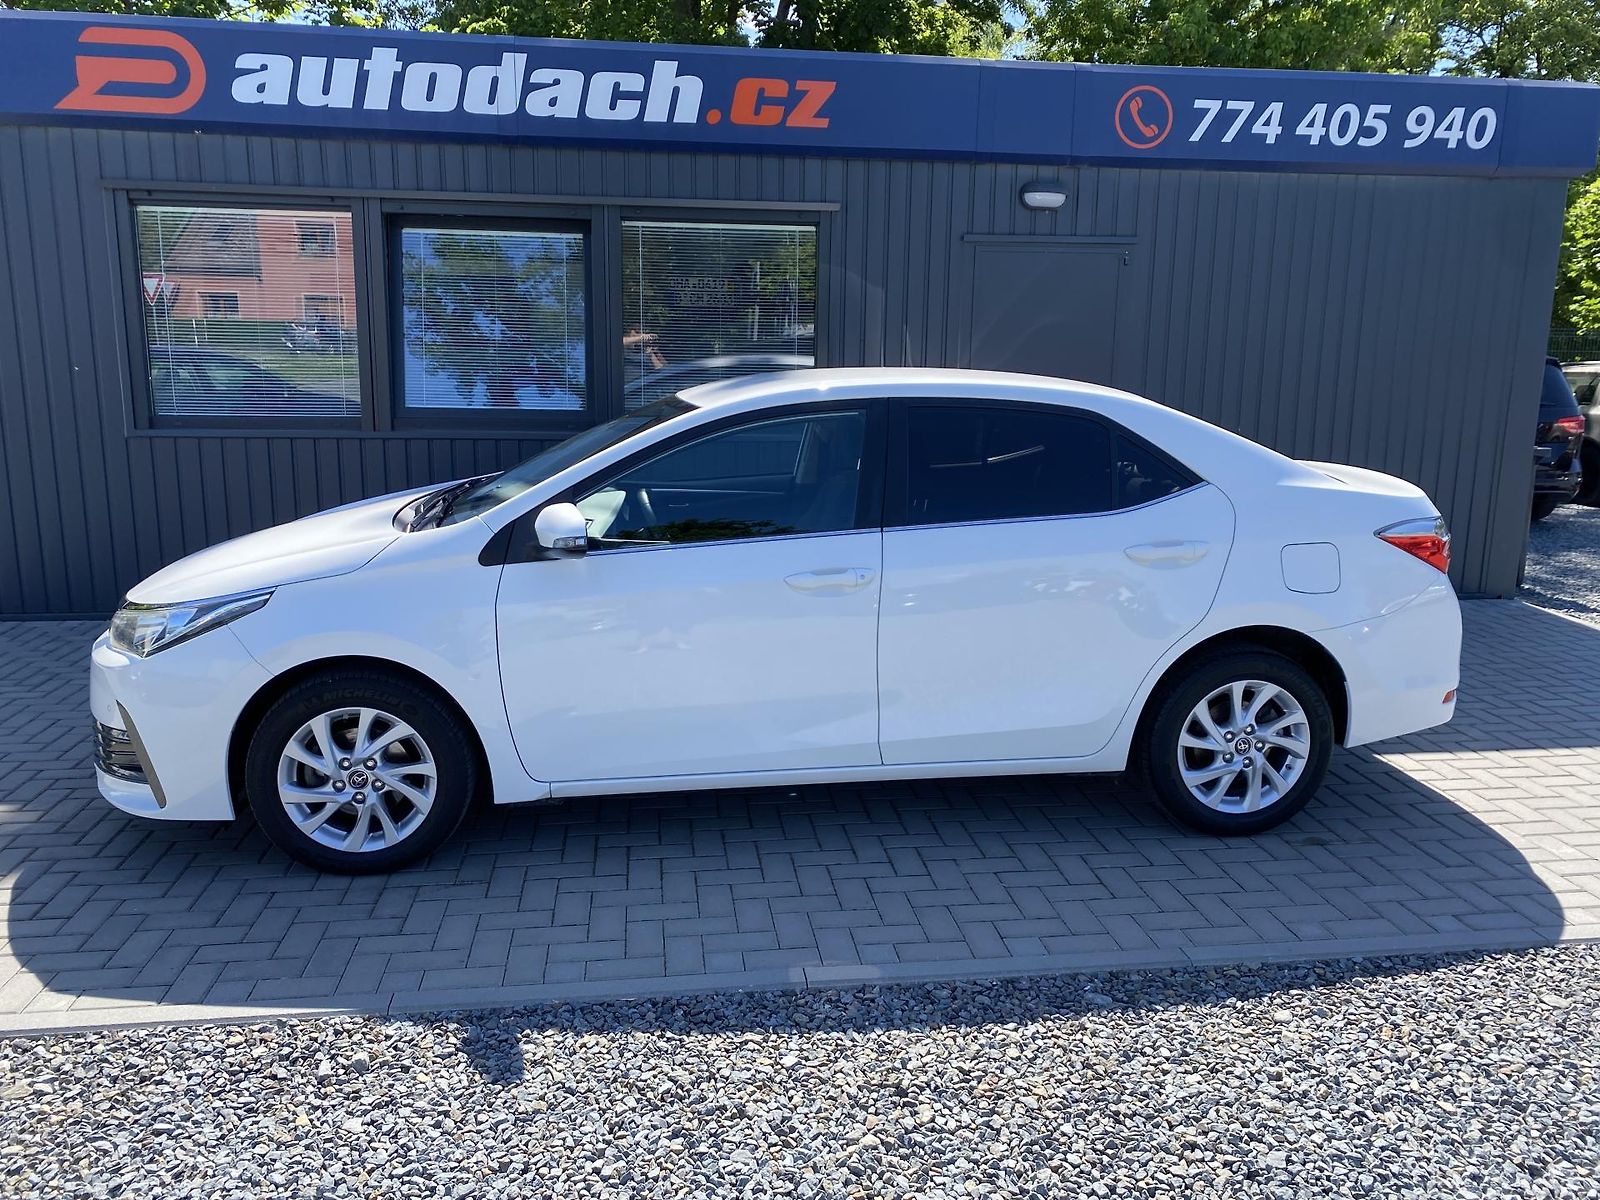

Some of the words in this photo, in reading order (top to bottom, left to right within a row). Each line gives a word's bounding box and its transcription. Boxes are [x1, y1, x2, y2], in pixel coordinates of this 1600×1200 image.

[231, 46, 837, 128] autodach.cz
[1189, 99, 1284, 143] 774
[1295, 103, 1392, 146] 405
[1404, 106, 1497, 149] 940
[323, 688, 400, 705] MICHELIN
